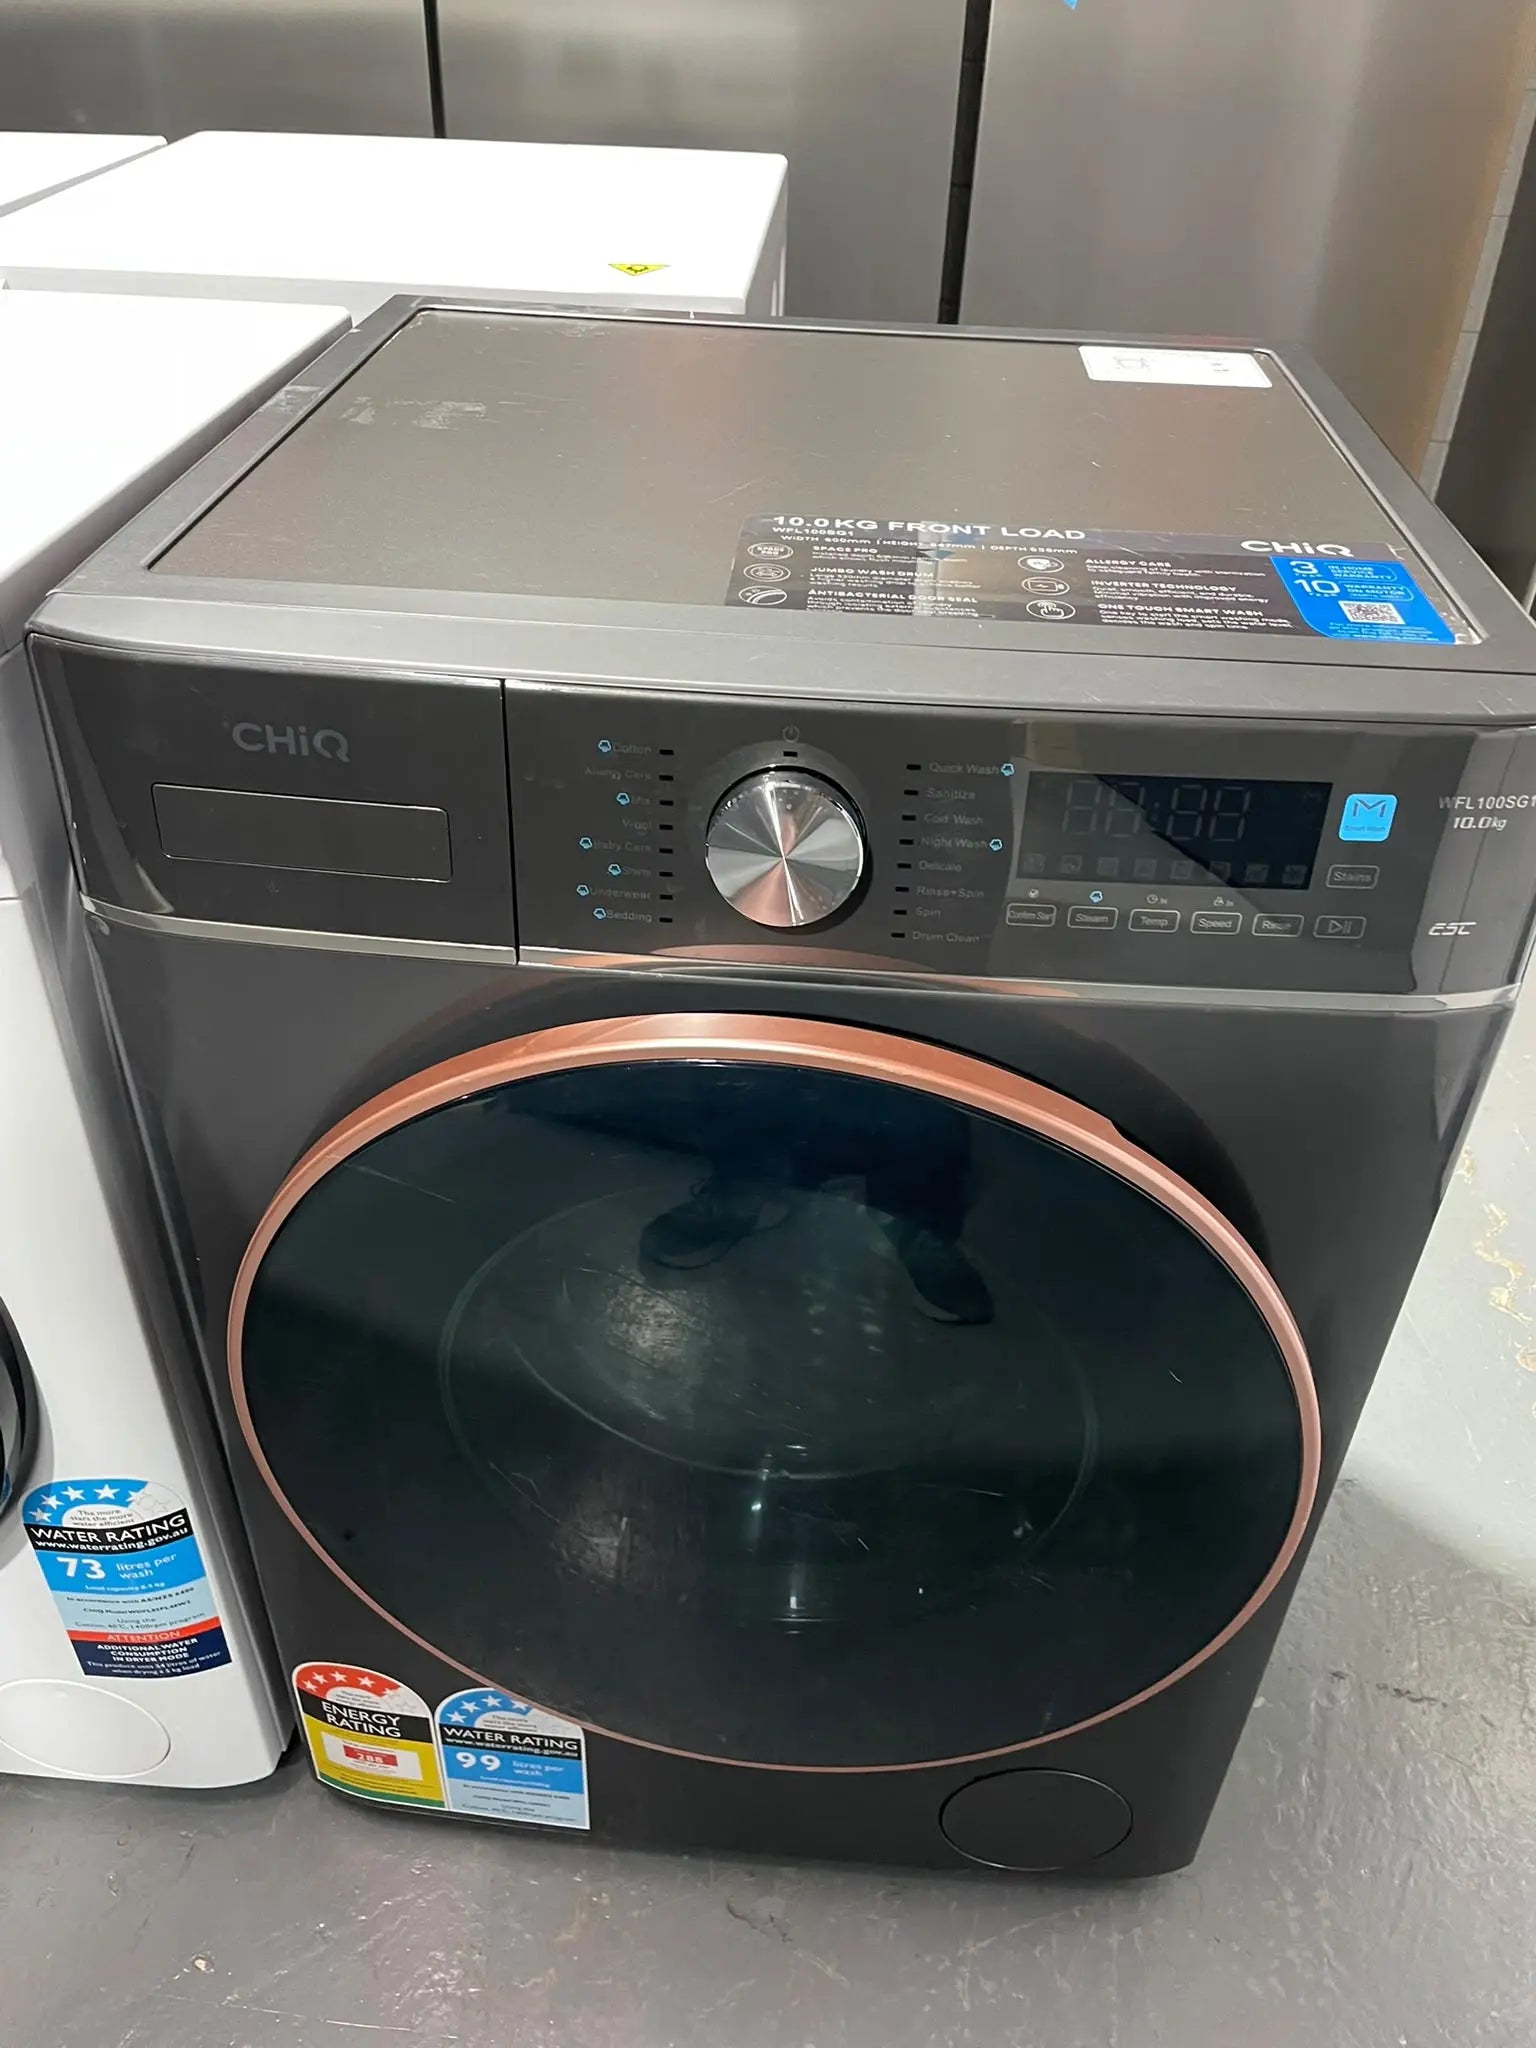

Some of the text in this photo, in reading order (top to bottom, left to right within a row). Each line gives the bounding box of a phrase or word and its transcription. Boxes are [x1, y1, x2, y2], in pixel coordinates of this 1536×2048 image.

[888, 521, 991, 536] FRONT
[1001, 527, 1086, 540] LOAD
[812, 545, 851, 553] SPACE
[1241, 540, 1354, 558] CHiQ
[1086, 558, 1136, 566] ALLERGY
[1289, 561, 1318, 574] 3
[857, 568, 895, 576] WASH
[1091, 580, 1150, 588] INVERTER
[1151, 583, 1237, 592] TECHNOLOGY
[1293, 579, 1340, 594] 10
[808, 589, 906, 600] ANTIBACTERIAL
[1126, 604, 1173, 612] TOUCH
[1175, 606, 1219, 614] SMART
[232, 722, 350, 763] CHiQ
[966, 763, 999, 775] Wash
[1439, 795, 1536, 810] WFL100SG1
[953, 813, 984, 826] Wash
[1453, 816, 1507, 830] 10.0kg
[955, 838, 988, 849] Wash
[606, 909, 652, 924] Bedding
[915, 906, 942, 920] Spin
[1140, 915, 1169, 928] Temp
[1198, 918, 1232, 930] Speed
[912, 930, 945, 941] Drum
[30, 1514, 186, 1543] WATER RATING
[35, 1527, 188, 1551] www.waterrating.gov.au
[56, 1557, 106, 1580] 73
[116, 1553, 177, 1572] litres per
[119, 1569, 154, 1580] wash
[107, 1630, 181, 1641] ATTENTION
[160, 1638, 198, 1649] WATER
[110, 1647, 188, 1657] CONSUMPTION
[158, 1652, 189, 1662] MODE
[321, 1701, 400, 1726] ENERGY
[326, 1713, 401, 1738] RATING
[443, 1726, 505, 1743] WATER
[510, 1735, 578, 1750] RATING
[456, 1752, 501, 1771] 99
[512, 1760, 565, 1772] litres per
[514, 1769, 543, 1777] wash
